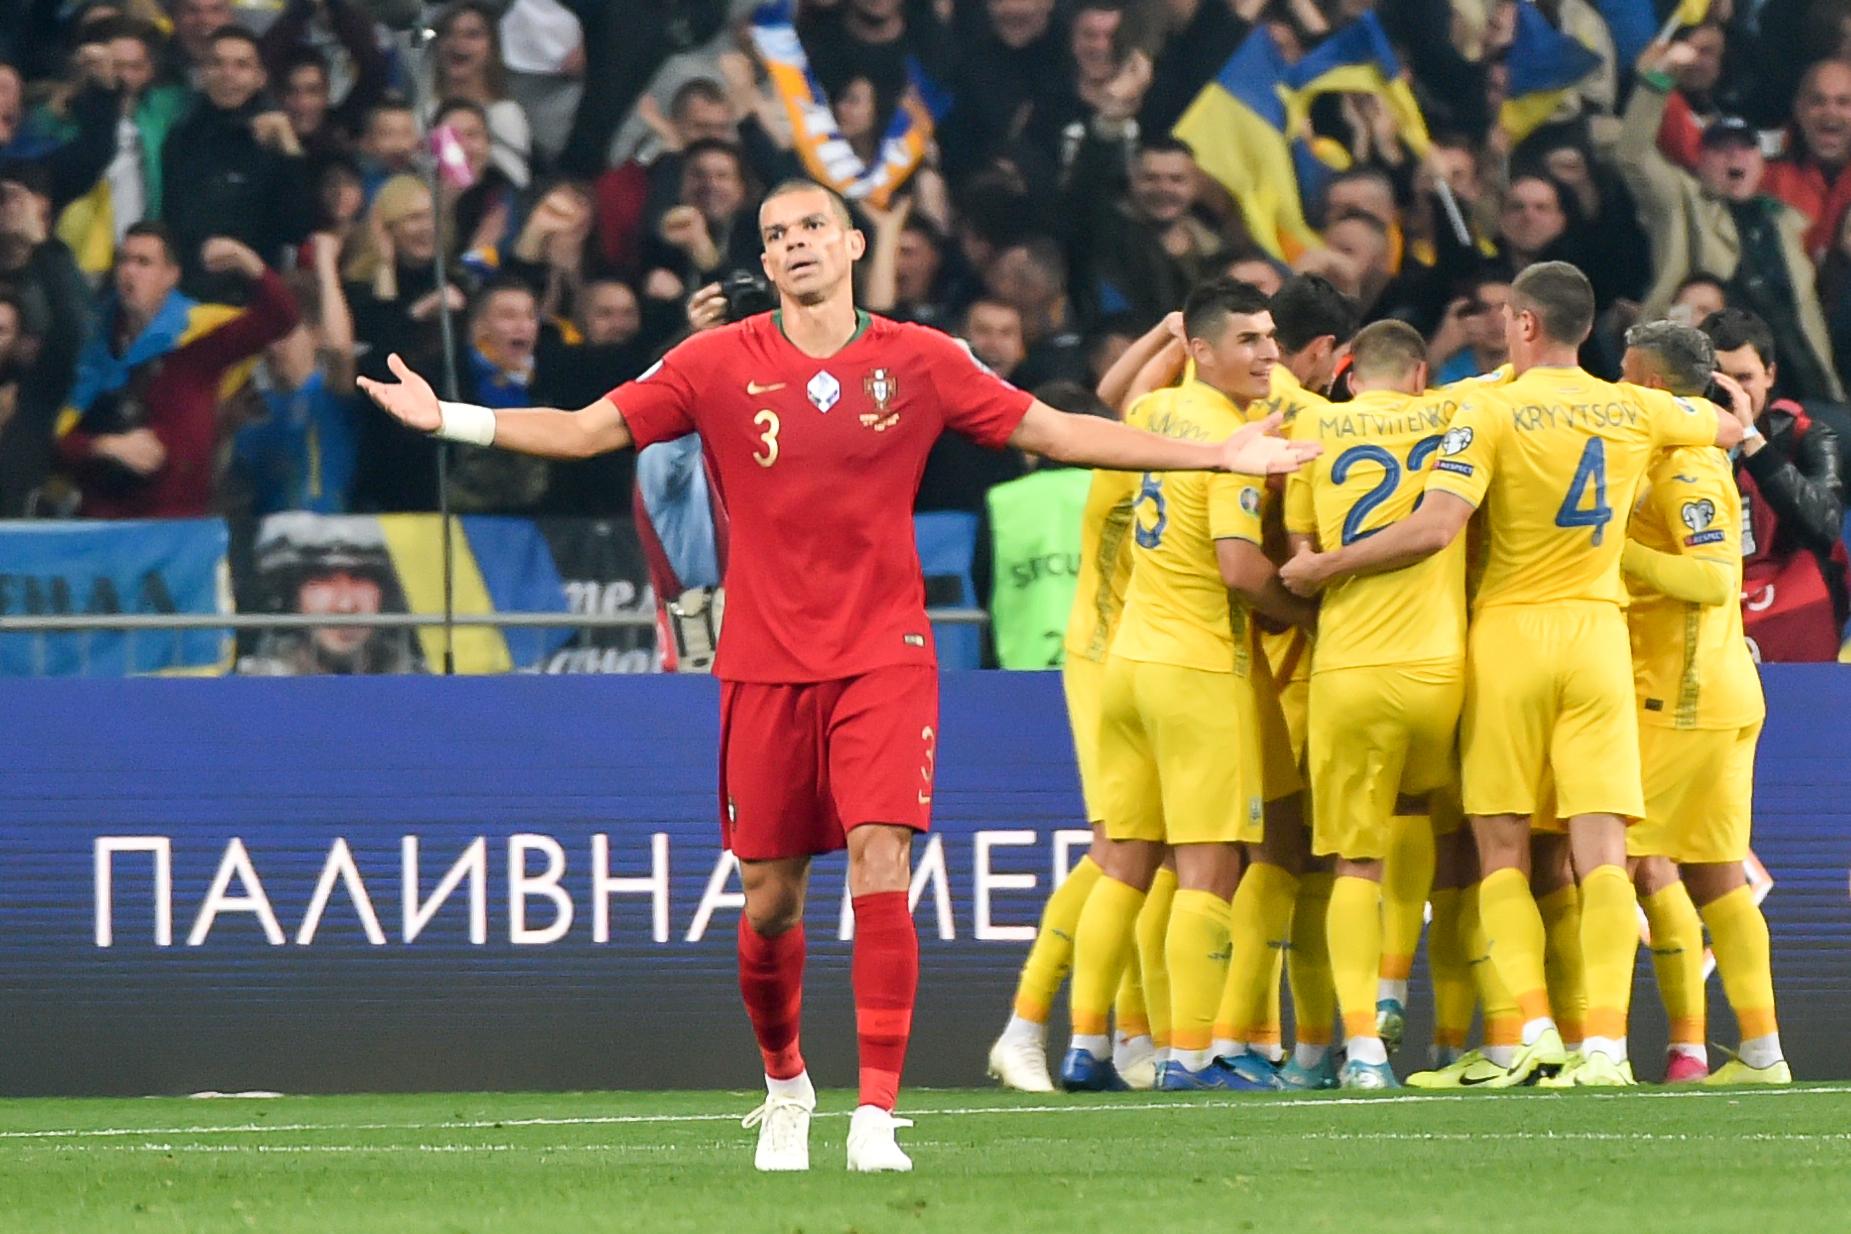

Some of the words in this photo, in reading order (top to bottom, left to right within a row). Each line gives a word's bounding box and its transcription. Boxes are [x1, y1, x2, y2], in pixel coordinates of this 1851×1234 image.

[753, 409, 780, 468] 3
[1512, 402, 1637, 433] KRYVTSOV
[1555, 436, 1614, 548] 4
